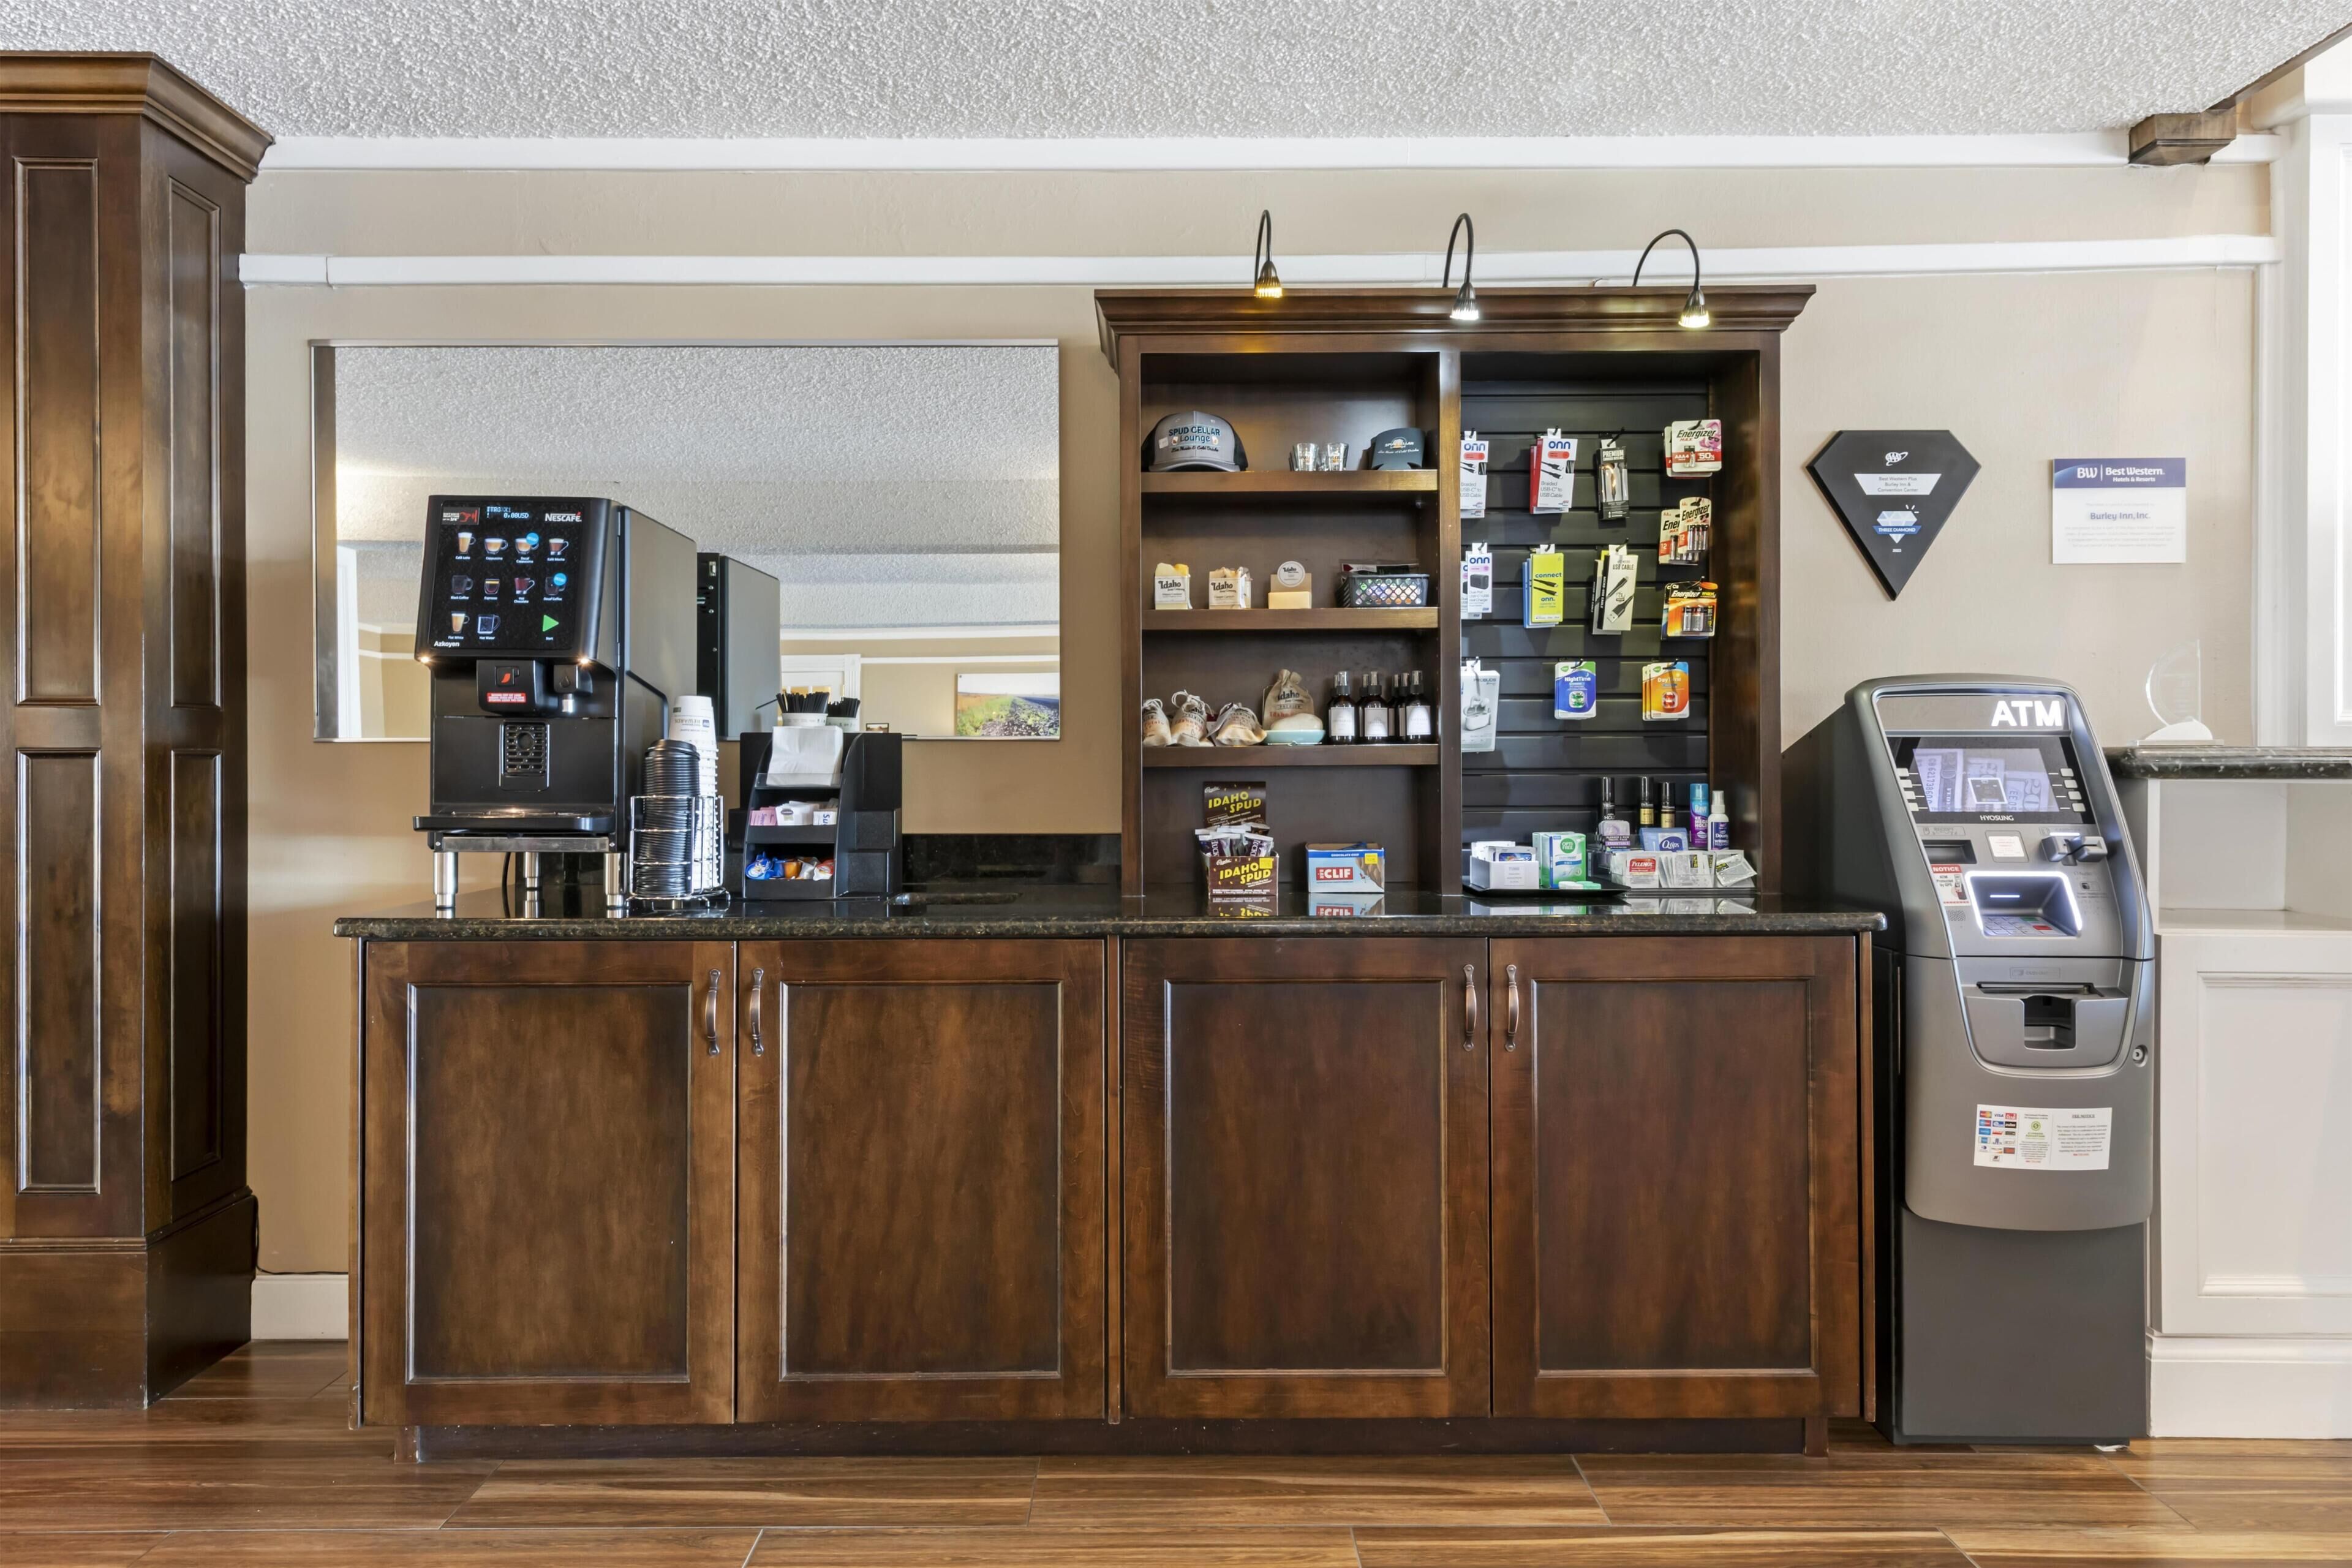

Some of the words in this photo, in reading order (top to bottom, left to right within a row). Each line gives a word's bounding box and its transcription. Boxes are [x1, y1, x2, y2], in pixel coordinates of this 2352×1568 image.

[1169, 426, 1189, 436] SPUD
[1191, 426, 1220, 436] CELLAR
[1676, 430, 1716, 439] Energizer
[1180, 435, 1210, 443] Lounge
[1548, 441, 1570, 450] onn
[2076, 467, 2098, 479] BW
[2106, 467, 2125, 475] Best
[1682, 505, 1710, 521] Energizer
[2090, 512, 2117, 521] Burley
[2119, 512, 2136, 521] Inn,
[1158, 579, 1181, 589] Idaho
[1210, 581, 1233, 591] Idaho
[1991, 699, 2063, 726] ATM
[1208, 791, 1249, 809] IDAHO
[1230, 798, 1262, 813] SPUD
[1219, 862, 1259, 880] IDAHO
[1324, 869, 1351, 878] CLIF
[1240, 869, 1272, 884] SPUD
